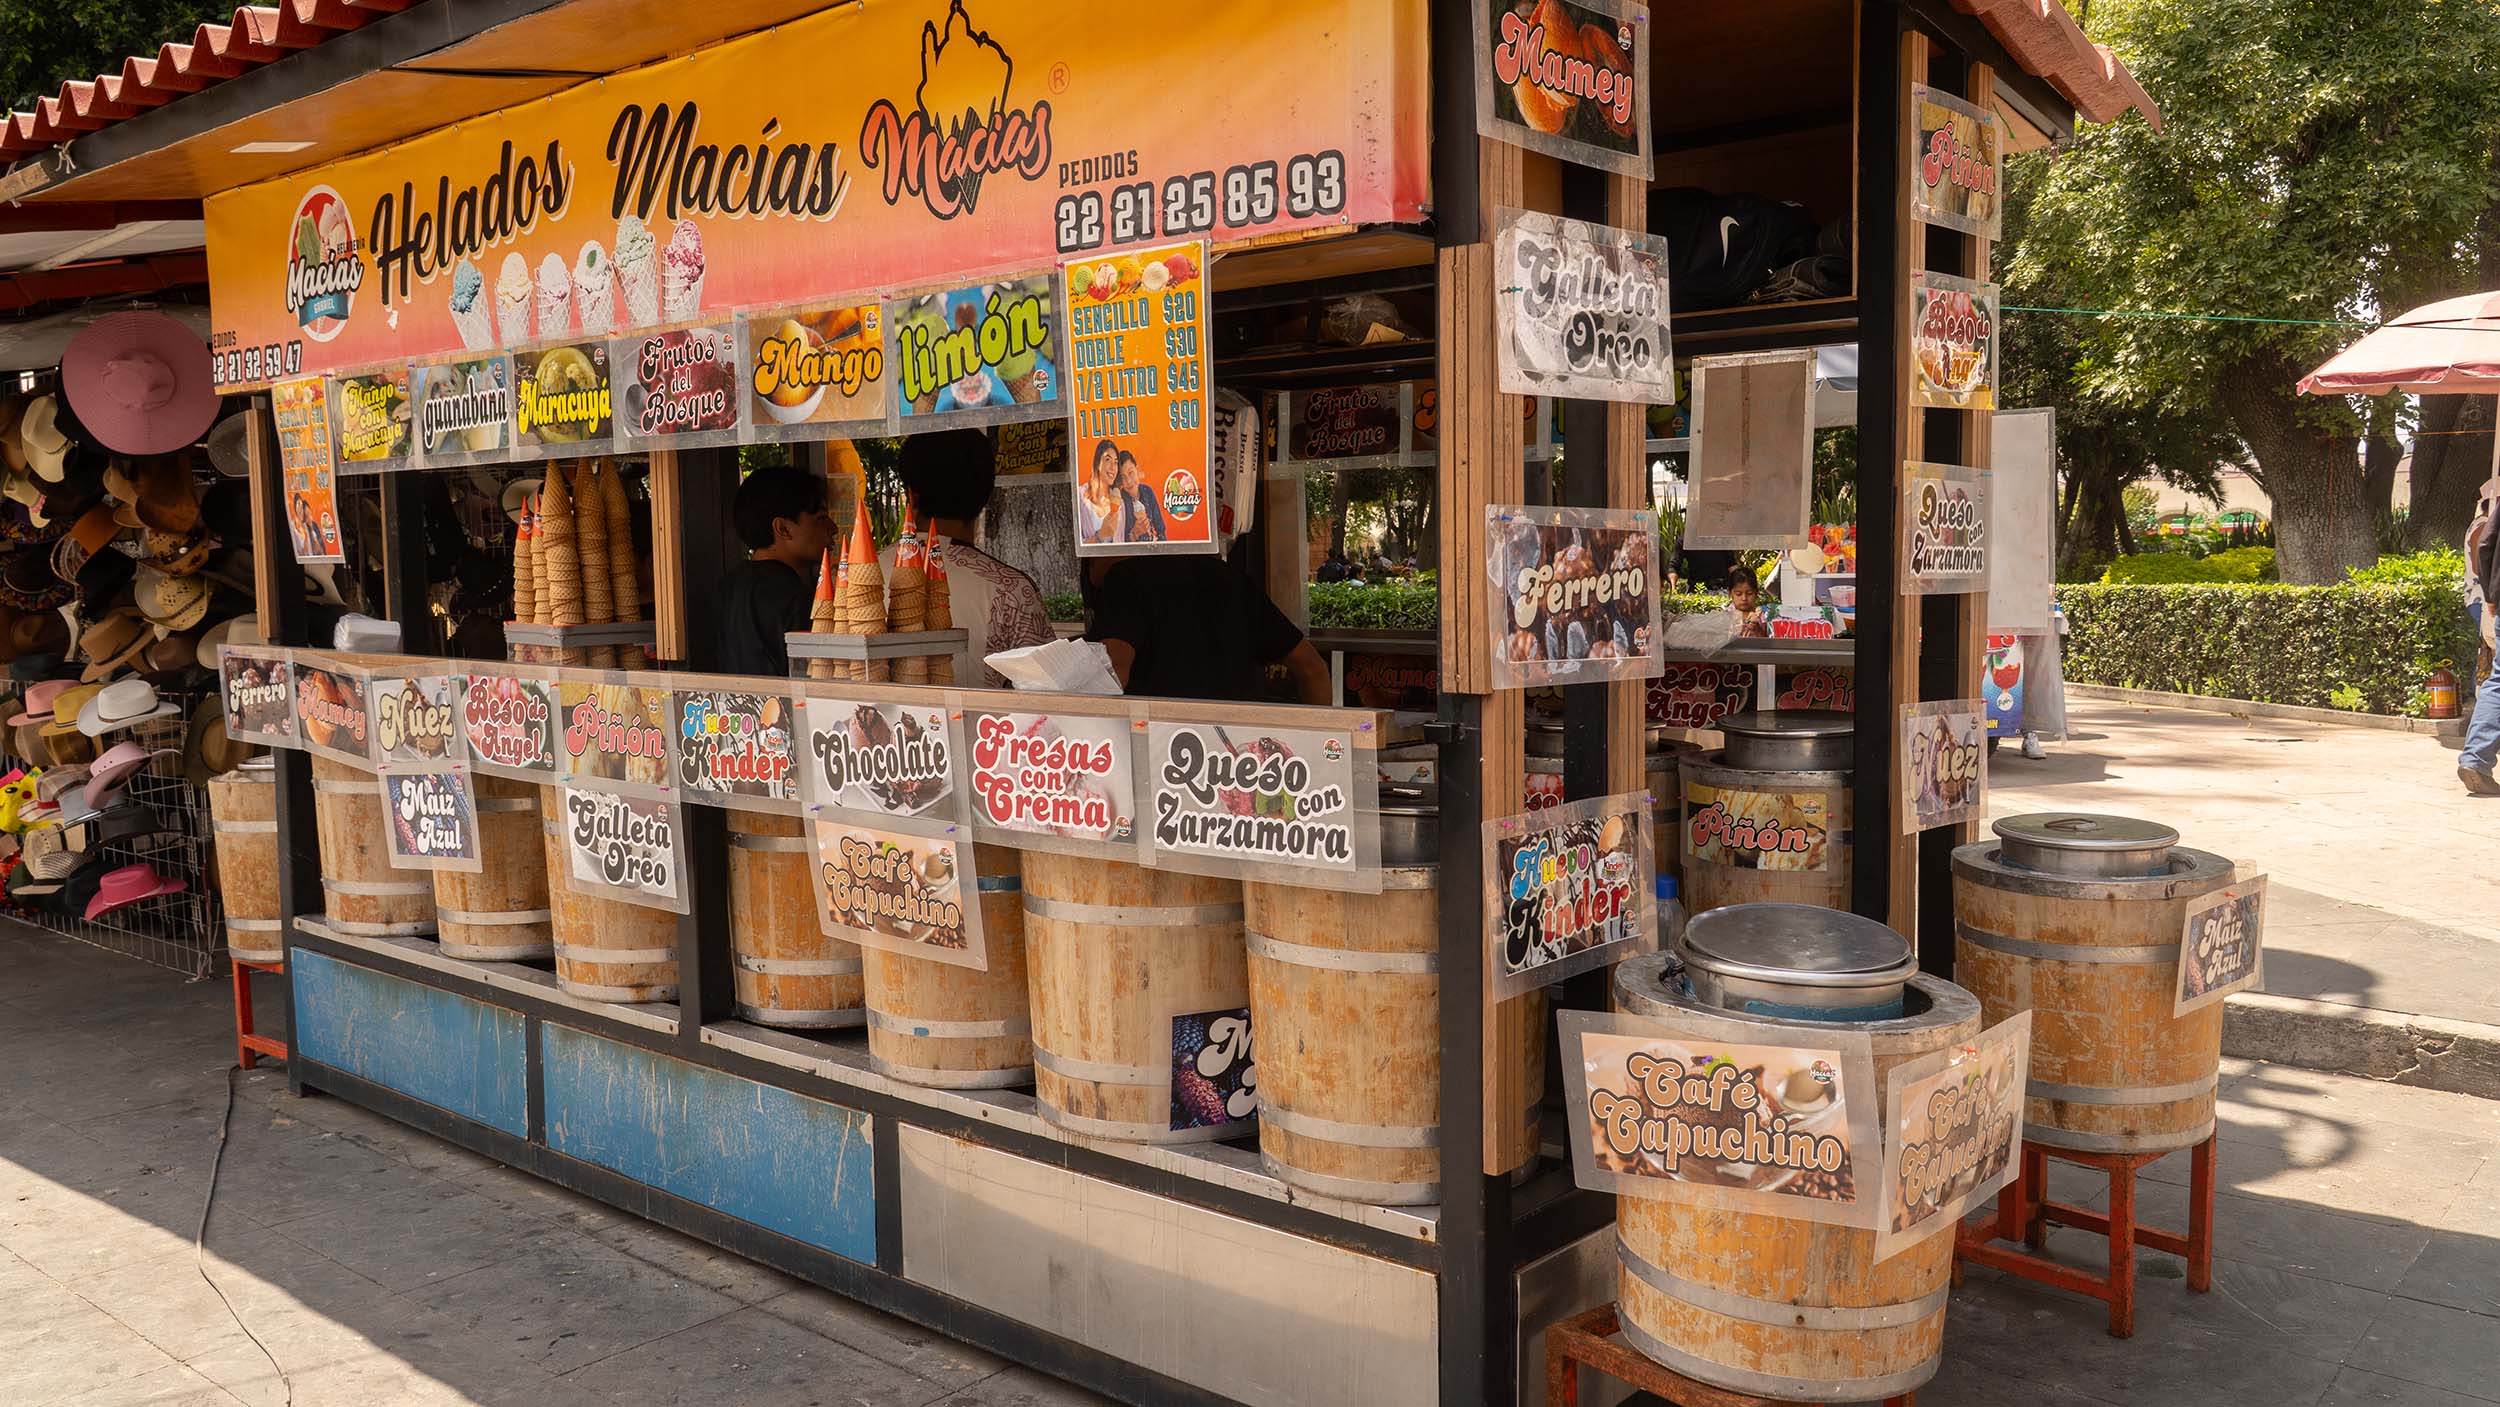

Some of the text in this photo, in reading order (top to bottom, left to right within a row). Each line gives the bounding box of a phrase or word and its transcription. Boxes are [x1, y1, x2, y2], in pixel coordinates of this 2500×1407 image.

[1494, 11, 1634, 124] Mamey
[1059, 150, 1138, 188] PEDIDOS
[1922, 120, 1996, 196] Piñón
[370, 101, 851, 311] Helados Macías
[1056, 150, 1345, 253] 22 21 25 85 93
[1517, 239, 1656, 319] Galleta
[212, 331, 237, 348] EDIDOS
[1073, 290, 1195, 338] SENCILLO $20
[1922, 291, 1992, 348] Beso de
[227, 349, 242, 384] 21
[245, 346, 261, 382] 32
[265, 343, 282, 379] 59
[285, 340, 303, 374] 47
[641, 333, 716, 381] Frutos
[899, 291, 1049, 403] limón
[1075, 325, 1198, 371] DOBLE $30
[1564, 309, 1651, 373] Oreo
[671, 369, 692, 392] del
[753, 337, 883, 398] Mango
[1077, 360, 1200, 404] 1/2 LITRO $45
[347, 383, 394, 415] Mango
[360, 408, 381, 427] con
[423, 374, 508, 449] guanabana
[517, 376, 612, 435] Maracuyá
[641, 388, 726, 435] Bosque
[1079, 400, 1199, 439] 1 LITRO $90
[1308, 389, 1381, 421] Frutos
[1334, 410, 1356, 430] del
[342, 416, 403, 460] Maracuyá
[1306, 425, 1386, 457] Bosque
[1918, 482, 1975, 543] Queso
[1967, 520, 1984, 546] con
[1910, 529, 1985, 577] Zarzamora
[1514, 563, 1645, 629] Ferrero
[229, 678, 287, 713] Ferrero
[1346, 655, 1437, 690] Mame
[1645, 666, 1719, 693] eso
[298, 680, 366, 742] Mamey
[379, 687, 454, 751] Nuez
[465, 677, 548, 726] Beso de
[565, 693, 665, 759] Piñón
[682, 698, 753, 738] Huevo
[481, 723, 542, 766] Angel
[680, 736, 790, 786] Kinder
[811, 724, 949, 794] Chocolate
[973, 713, 1113, 774] Fresas
[1161, 727, 1311, 809] Queso
[1909, 726, 1979, 804] Nuez
[973, 770, 1111, 831] Crema
[1020, 765, 1066, 795] con
[1295, 783, 1345, 820] con
[417, 816, 463, 854] Azul
[568, 793, 671, 849] Galleta
[1153, 788, 1352, 863] Zarzamora
[1691, 800, 1810, 852] Piñón
[603, 841, 668, 886] Oreo
[840, 836, 912, 883] Café
[1510, 837, 1590, 900] Huevo
[823, 861, 961, 929] Capuchino
[1504, 875, 1631, 968] Kinder
[2206, 942, 2243, 985] Azul
[1627, 1050, 1759, 1112] Café
[1590, 1087, 1846, 1174] Capuchino
[1928, 1075, 1988, 1141] Café
[1900, 1112, 2012, 1207] Capuchino
